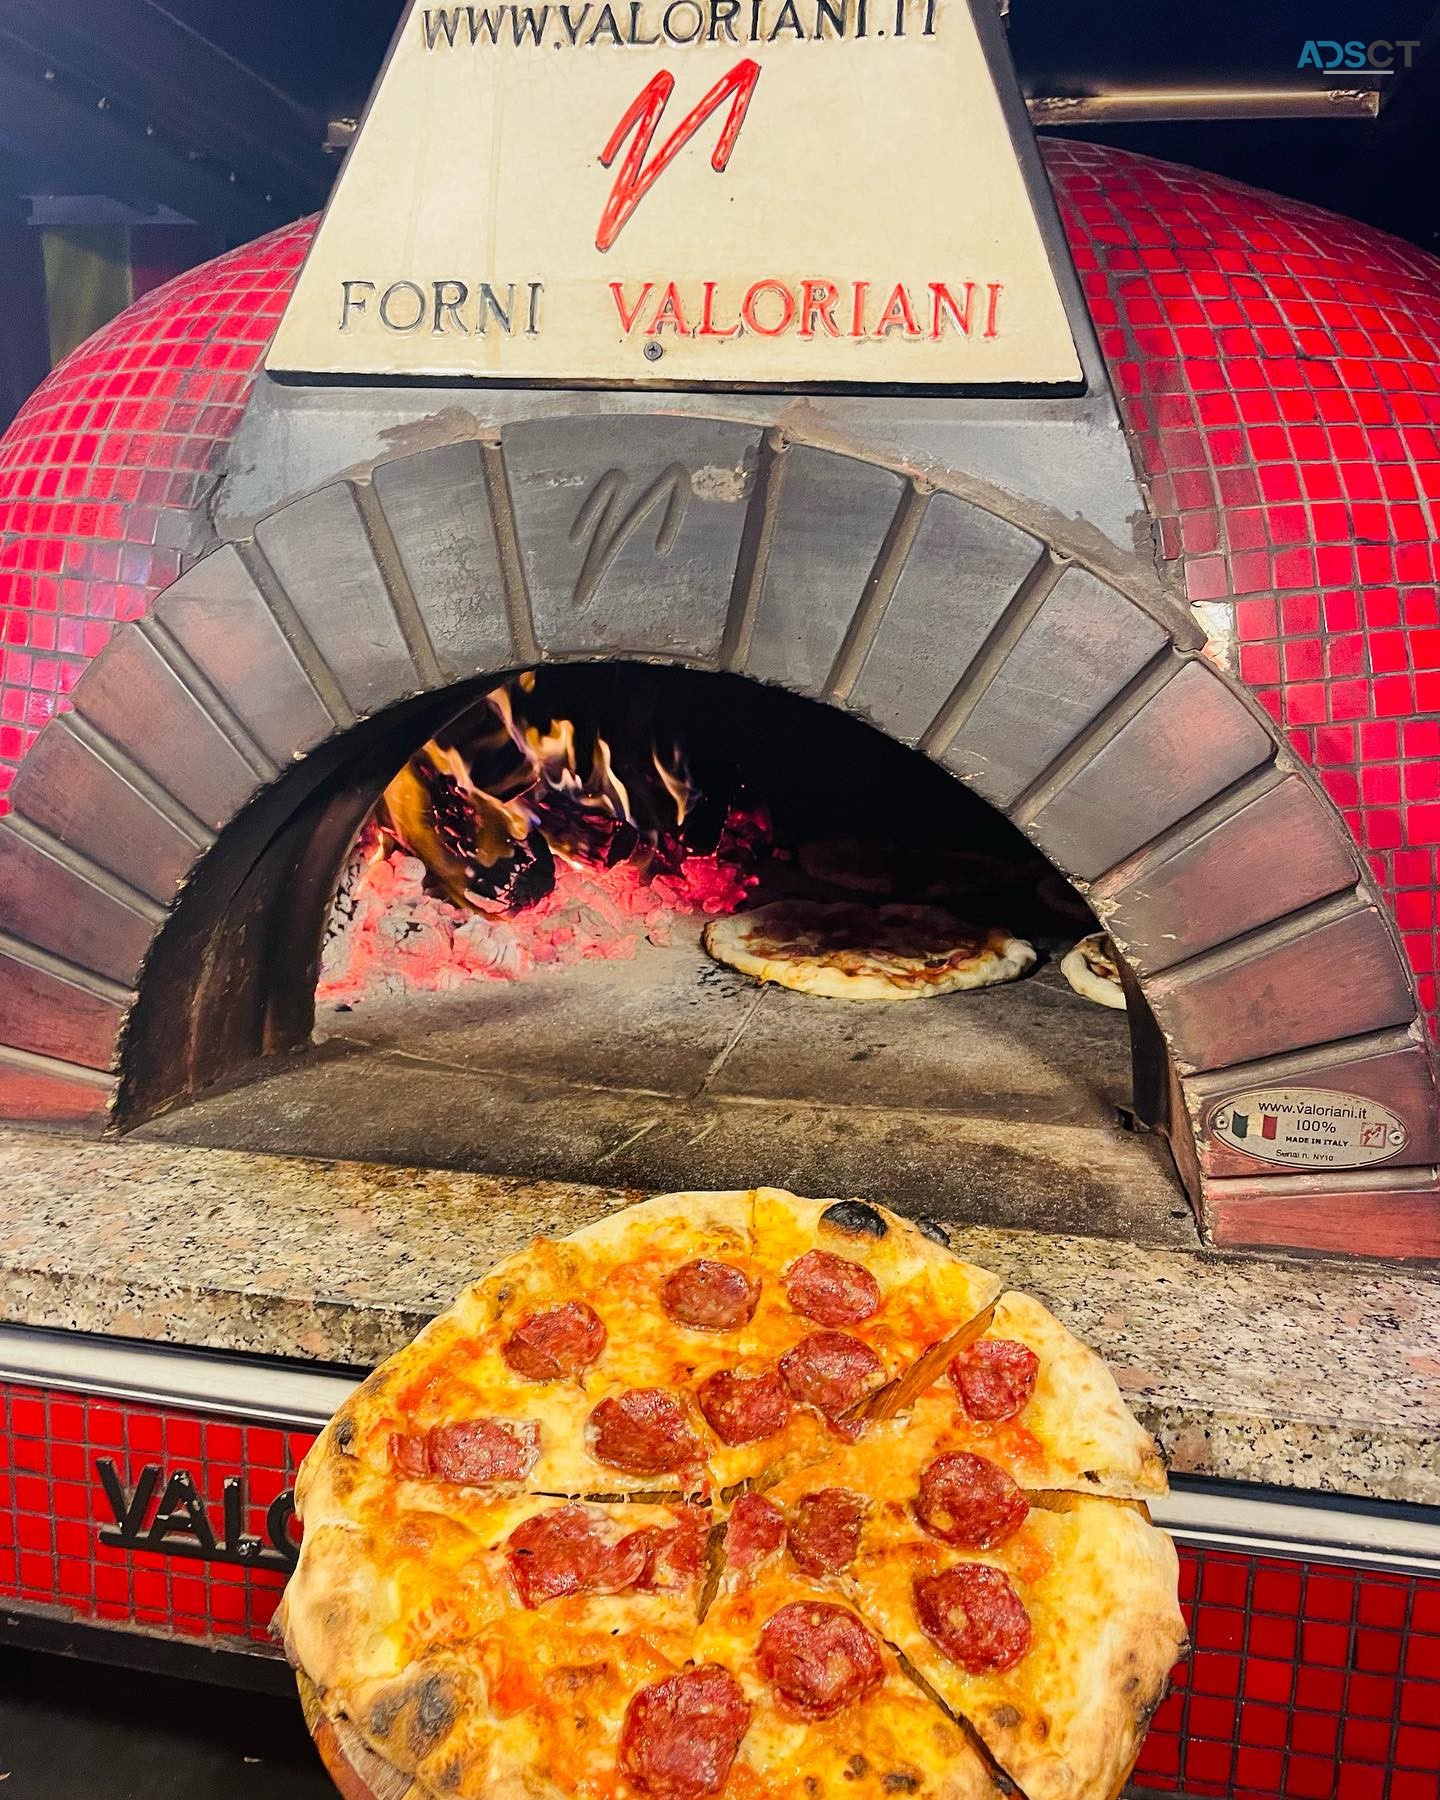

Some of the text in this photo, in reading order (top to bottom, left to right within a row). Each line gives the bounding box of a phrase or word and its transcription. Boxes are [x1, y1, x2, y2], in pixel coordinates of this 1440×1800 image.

[338, 279, 1003, 340] FORNI VALORIANI
[1258, 1102, 1367, 1119] www.valoriani.it
[1297, 1119, 1336, 1133] 100%
[1285, 1136, 1309, 1144] MADE
[1323, 1139, 1349, 1147] ITALY
